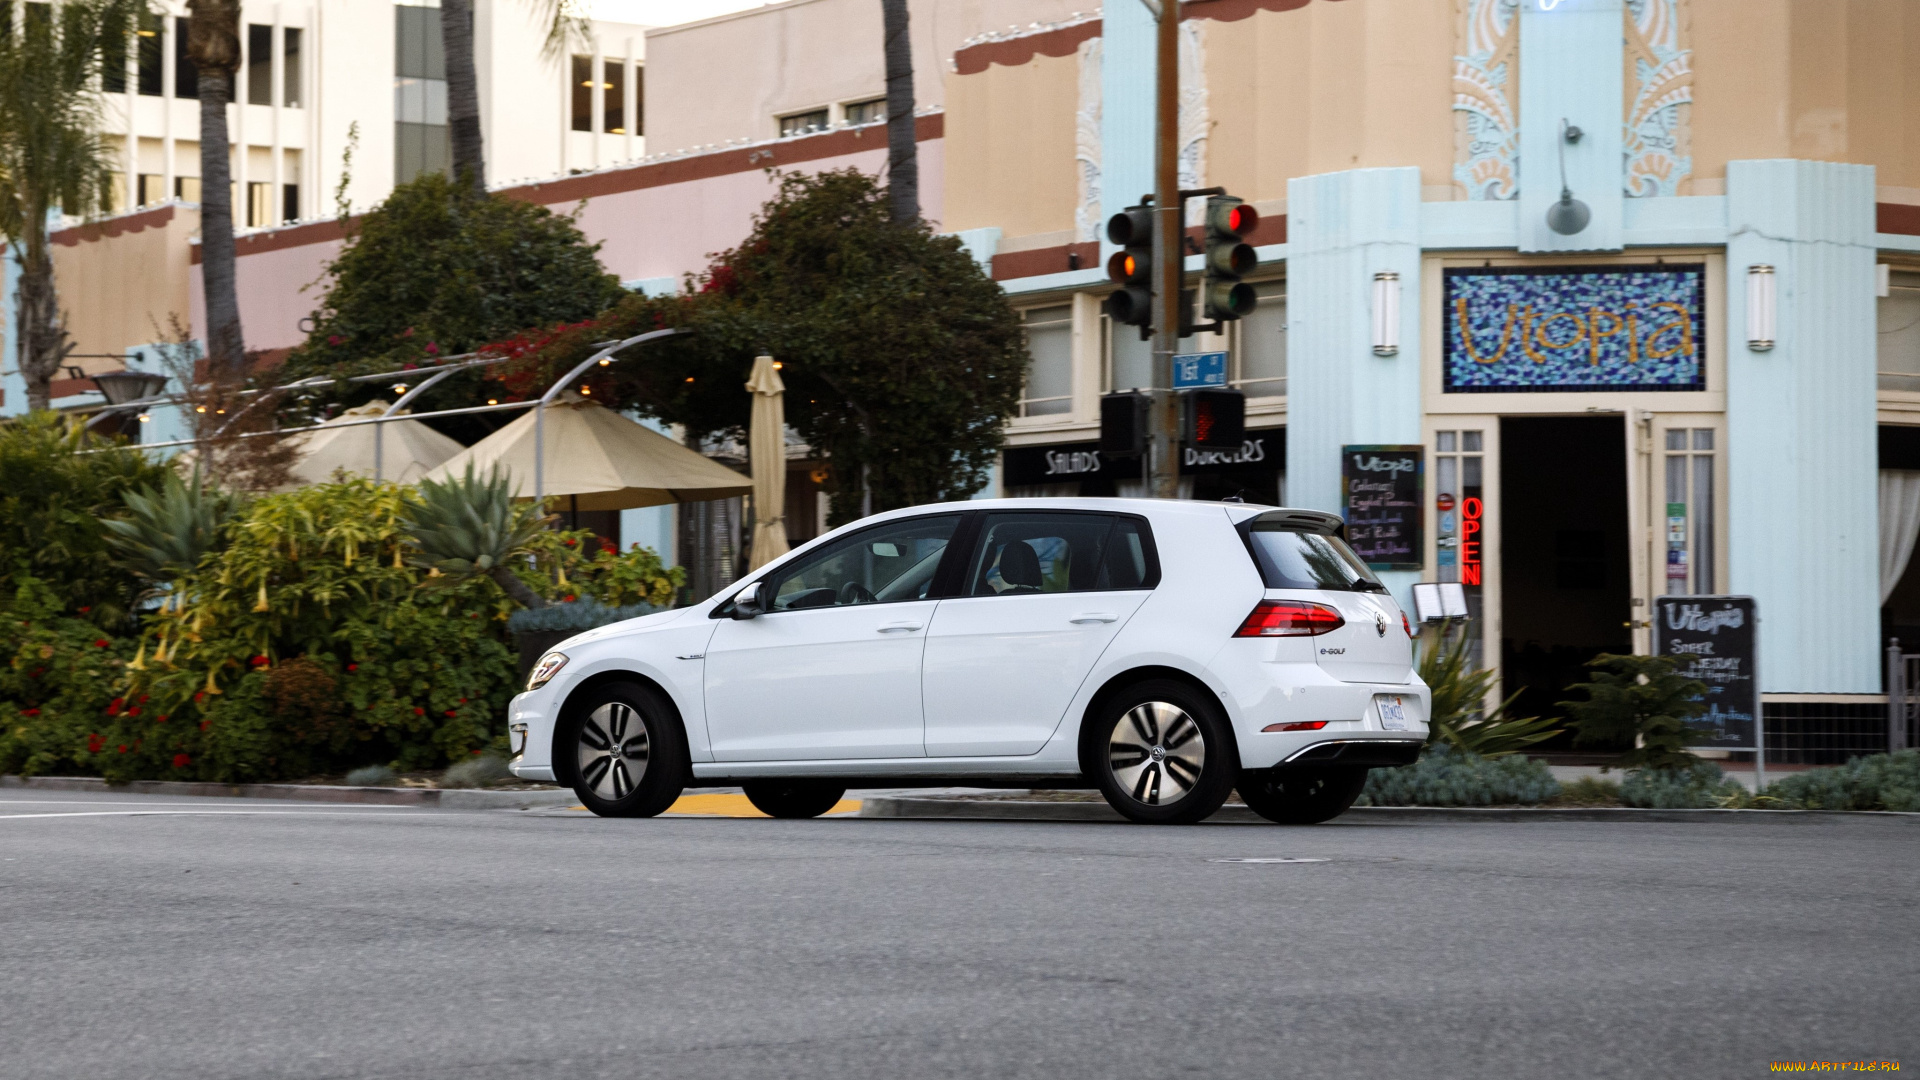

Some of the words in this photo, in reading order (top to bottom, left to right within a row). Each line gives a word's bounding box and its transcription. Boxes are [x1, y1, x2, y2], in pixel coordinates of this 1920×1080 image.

[1456, 297, 1695, 366] Utopia
[1044, 450, 1101, 475] SALADS
[1353, 454, 1416, 480] Utopia
[1461, 497, 1484, 586] OPEN
[1664, 602, 1745, 635] Utopia
